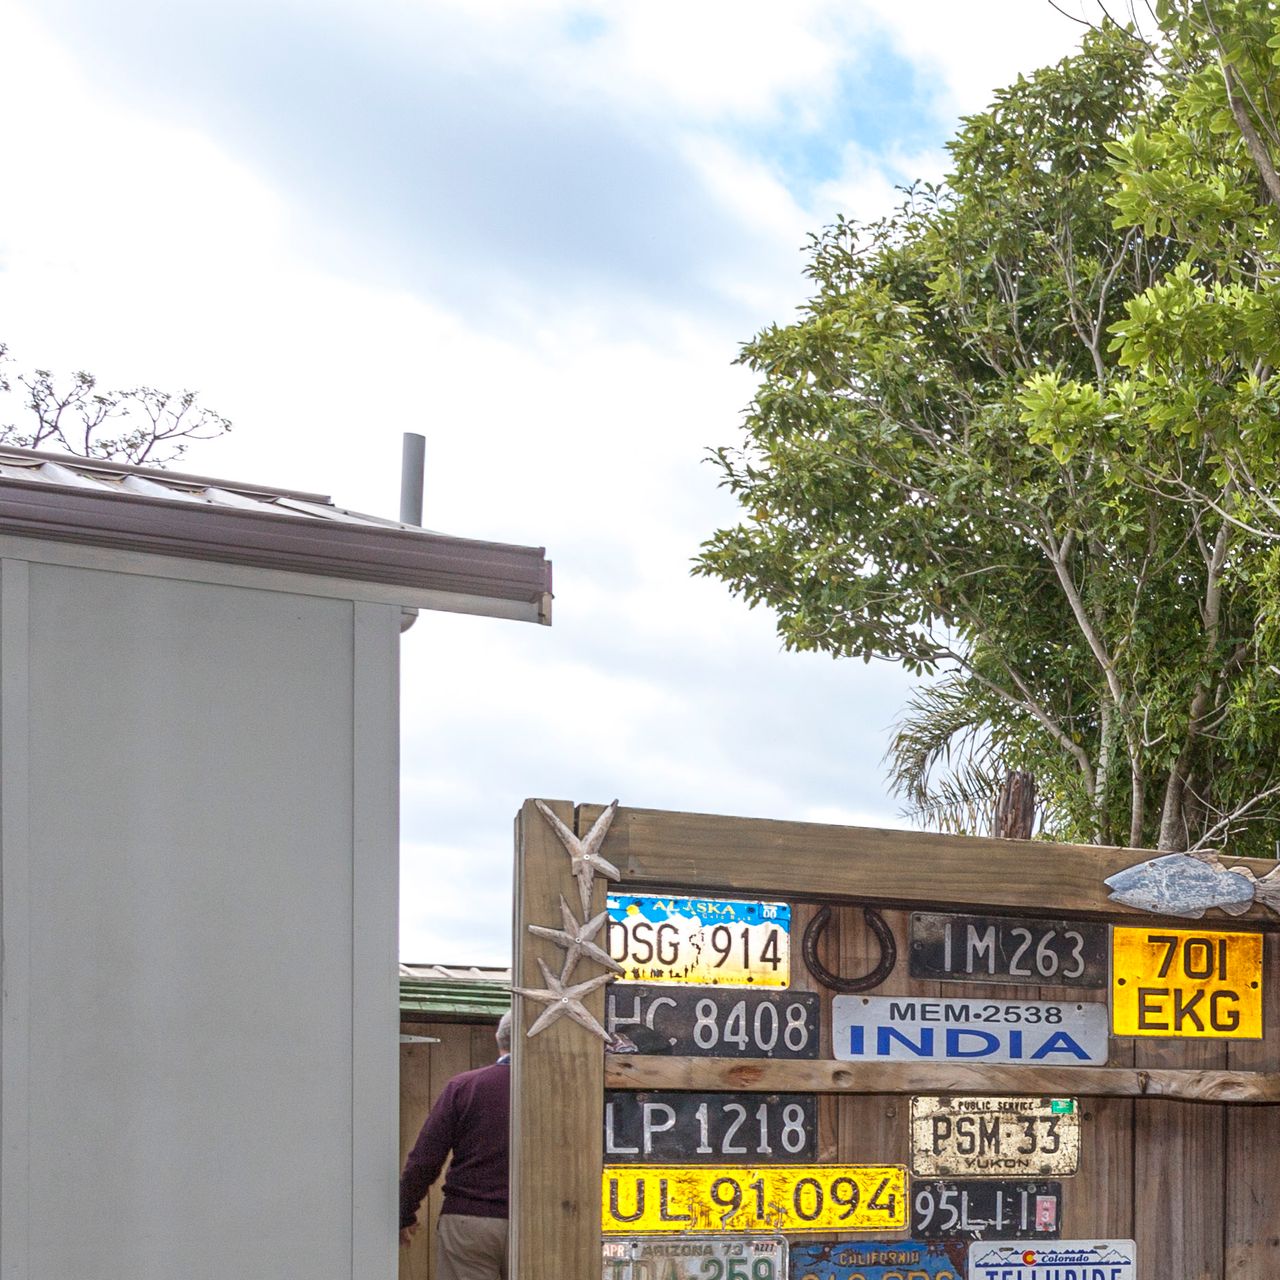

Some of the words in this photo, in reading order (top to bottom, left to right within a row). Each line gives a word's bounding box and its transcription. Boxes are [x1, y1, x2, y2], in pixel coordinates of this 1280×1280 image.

[711, 925, 782, 971] 914
[1148, 935, 1227, 981] 701
[1138, 988, 1240, 1032] EKG
[693, 999, 808, 1051] 8408
[850, 1025, 1092, 1060] INDIA
[958, 1101, 990, 1110] PUBLIC
[998, 1101, 1034, 1111] SERVICE
[606, 1102, 676, 1154] LP
[696, 1103, 806, 1154] 1218
[964, 1158, 1029, 1168] YUKON
[603, 1244, 625, 1257] APR
[641, 1243, 714, 1257] ARIZONA
[721, 1243, 744, 1256] 73
[840, 1251, 920, 1265] CALIFORNIA
[1041, 1254, 1090, 1263] Colorado
